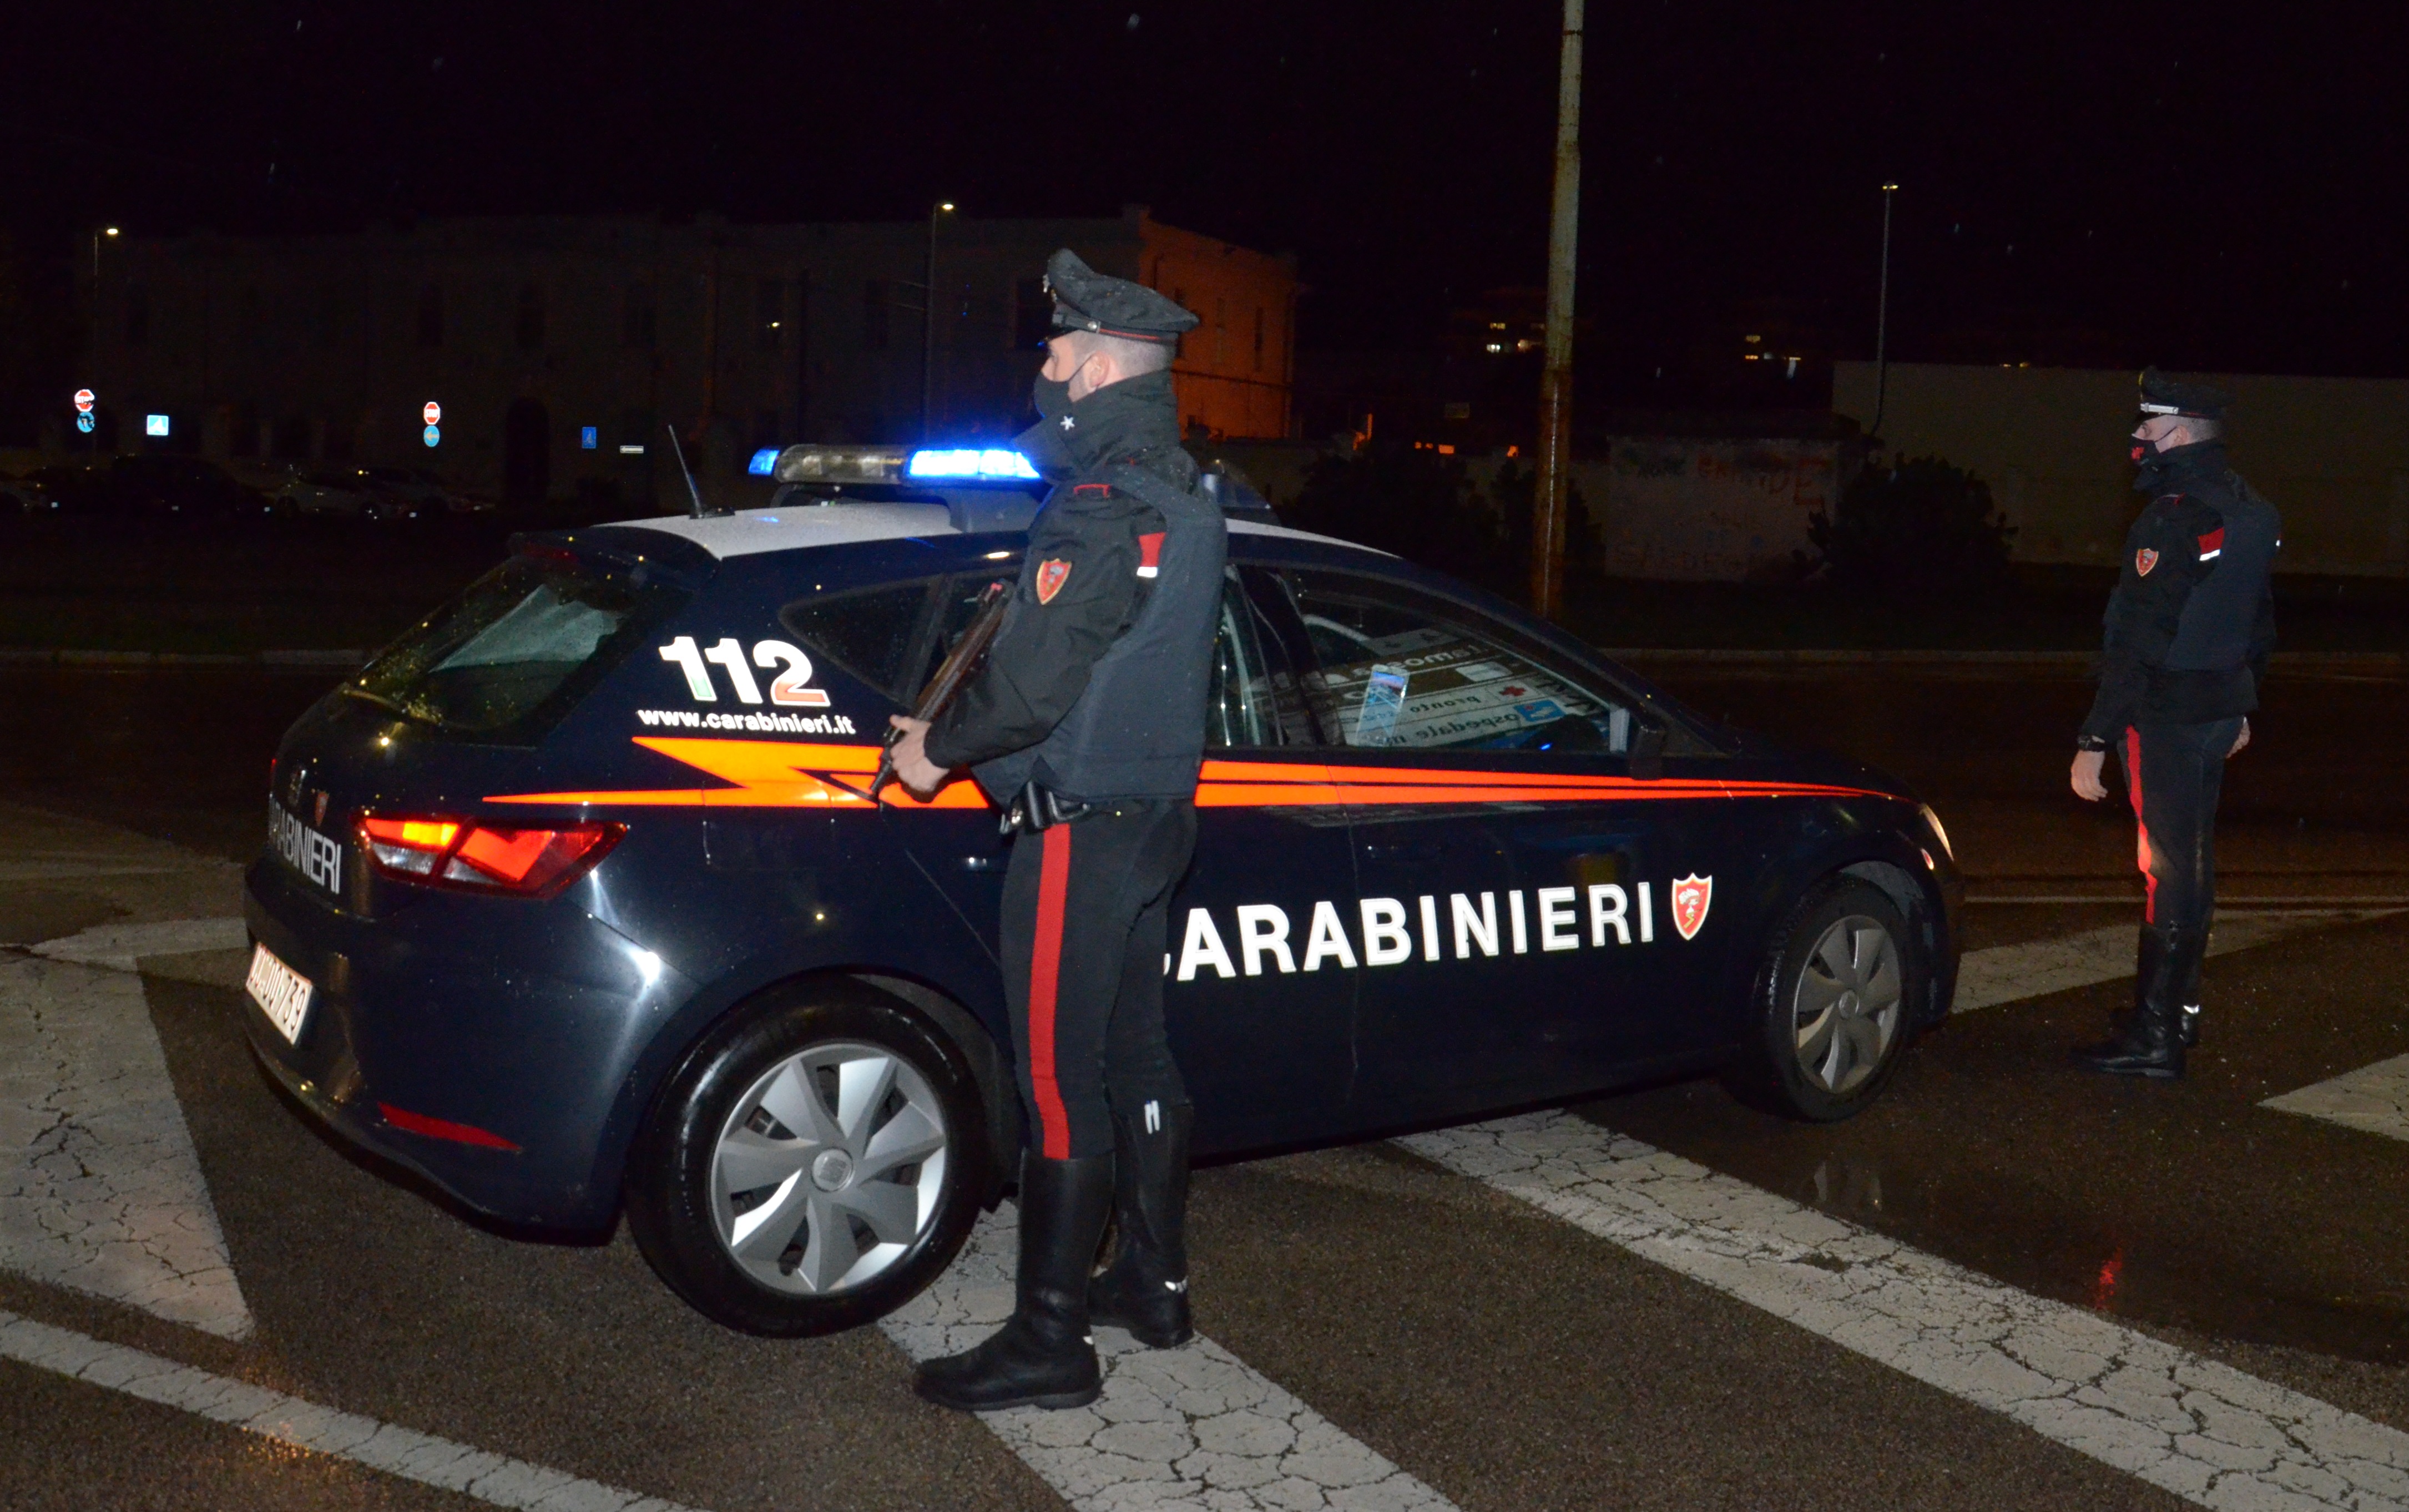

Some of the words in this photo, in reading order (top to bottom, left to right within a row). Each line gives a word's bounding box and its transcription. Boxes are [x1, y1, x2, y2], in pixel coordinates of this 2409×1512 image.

[425, 408, 439, 418] STOP
[659, 636, 831, 707] 112
[638, 709, 856, 735] www.carabinieri.it
[269, 799, 342, 894] RABINIERI
[1163, 881, 1654, 981] ARABINIERI
